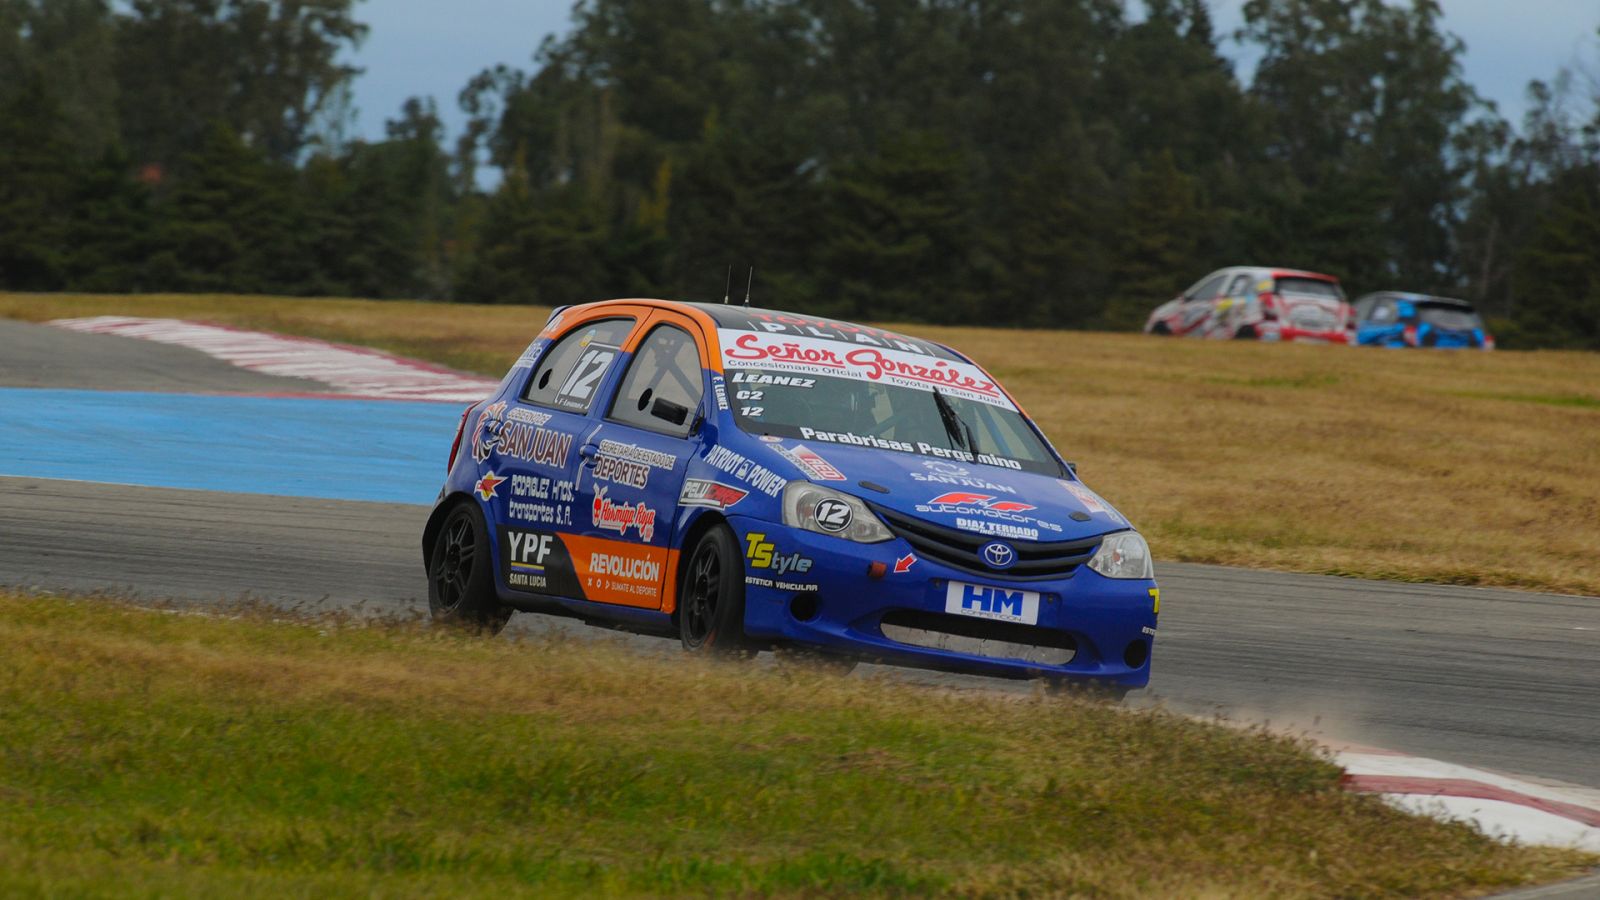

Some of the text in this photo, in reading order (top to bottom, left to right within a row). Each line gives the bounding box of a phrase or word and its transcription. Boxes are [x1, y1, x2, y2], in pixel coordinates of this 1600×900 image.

[561, 349, 614, 399] 12
[725, 334, 1000, 392] Señor González
[728, 359, 862, 378] Concesionario Oficial
[732, 372, 816, 388] LEANEZ
[891, 377, 929, 390] Toyota
[951, 388, 975, 399] San
[979, 394, 1005, 406] Juan
[736, 390, 764, 400] C2
[740, 406, 764, 416] 12
[496, 420, 573, 470] SAN JUAN
[800, 426, 1022, 471] Parabrisas Pergamino
[592, 453, 650, 489] DEPORTES
[703, 444, 744, 475] PATRIOT
[745, 464, 787, 498] POWER
[910, 472, 1017, 494] SAN JUAN
[509, 498, 554, 523] transportes
[818, 502, 850, 525] 12
[915, 504, 1063, 532] automotores
[956, 517, 1039, 538] DIAZ TERRADO
[508, 531, 553, 564] YPF
[745, 532, 812, 575] TStyle
[509, 573, 547, 588] SANTA LUCIA
[589, 552, 660, 582] REVOLUCIÓN
[611, 583, 657, 597] SUMATE AL DEPORTE
[745, 576, 818, 592] ESTETICA VEHICULAR
[962, 584, 1024, 616] HM
